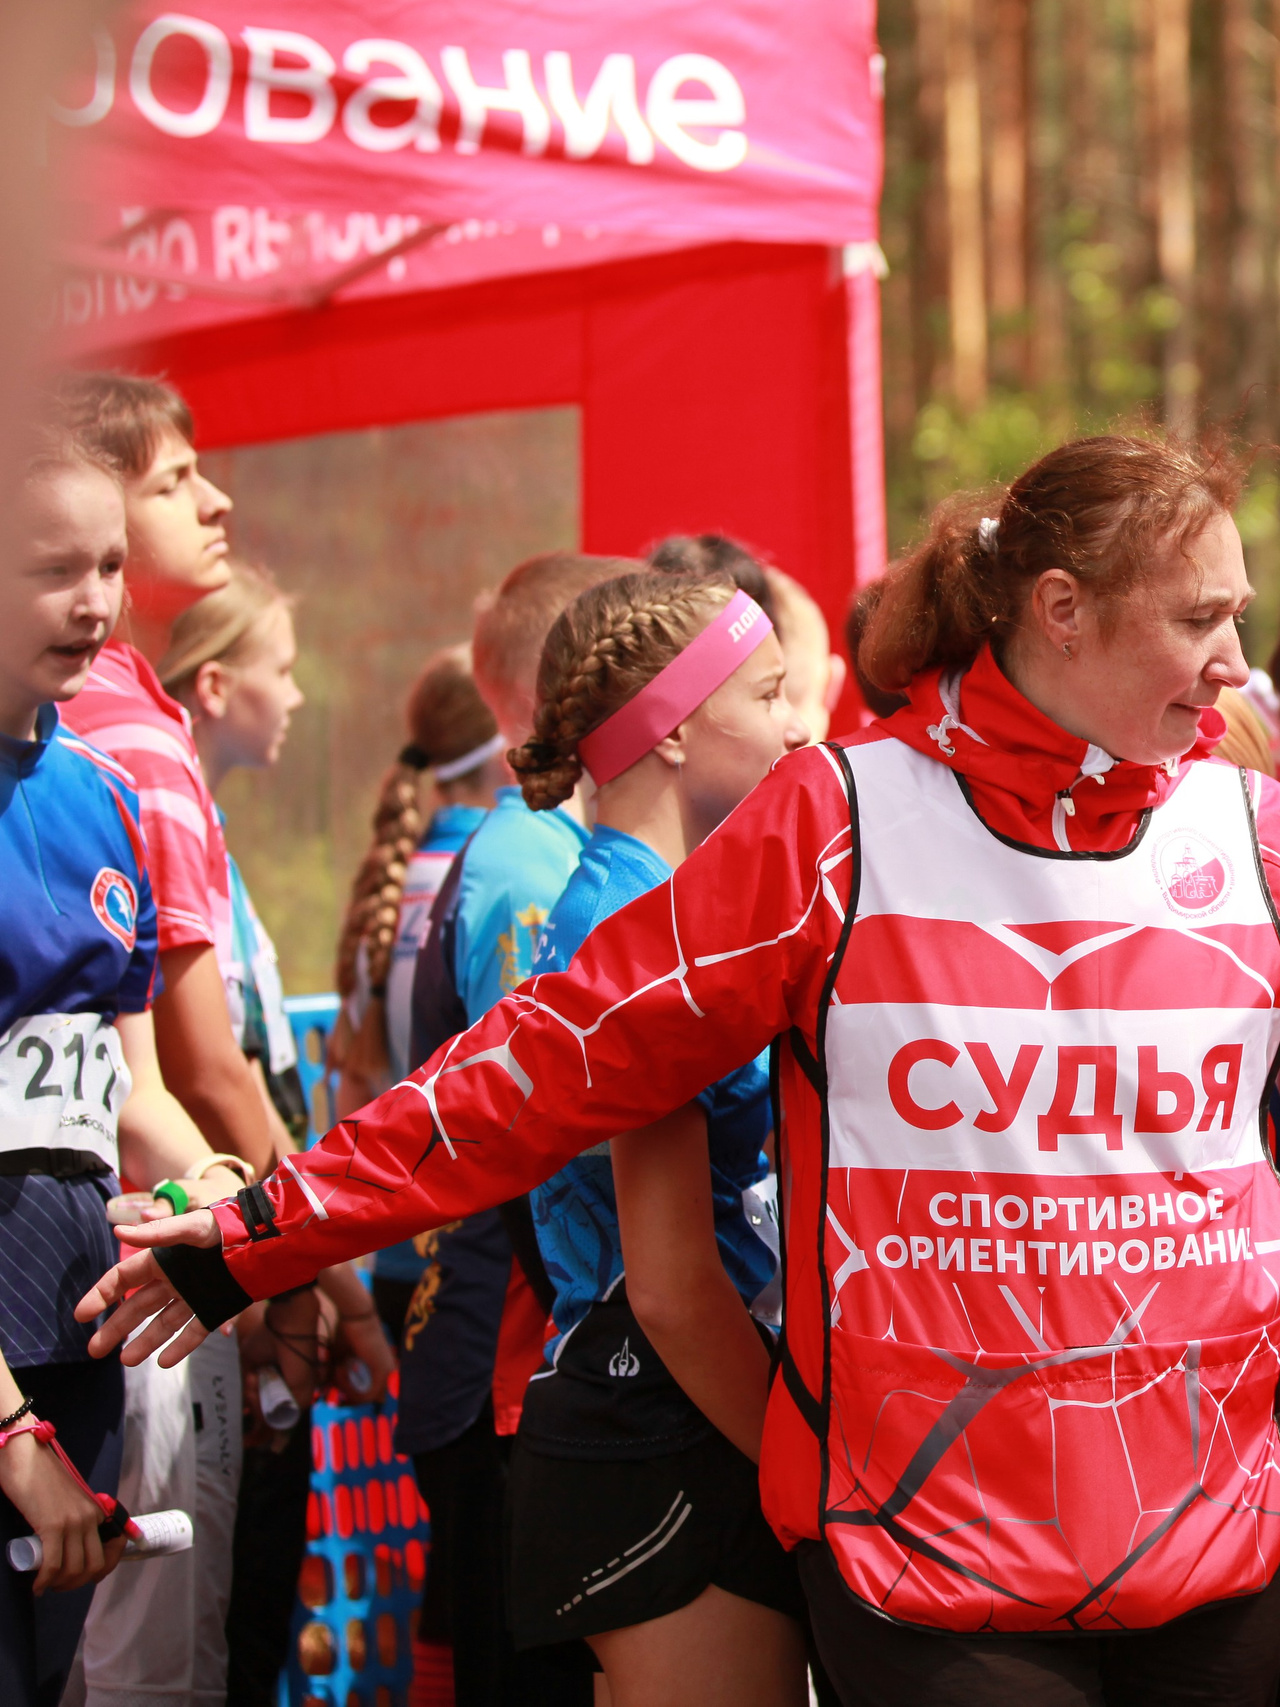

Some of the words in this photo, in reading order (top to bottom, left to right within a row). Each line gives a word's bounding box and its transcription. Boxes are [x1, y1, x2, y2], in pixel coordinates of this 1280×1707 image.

[1156, 826, 1197, 843] спортивного
[1199, 832, 1235, 886] ориентирования
[1162, 891, 1207, 920] Владимирской
[1207, 891, 1231, 915] области
[887, 1038, 1244, 1152] СУДЬЯ
[928, 1187, 1225, 1231] СПОРТИВНОЕ
